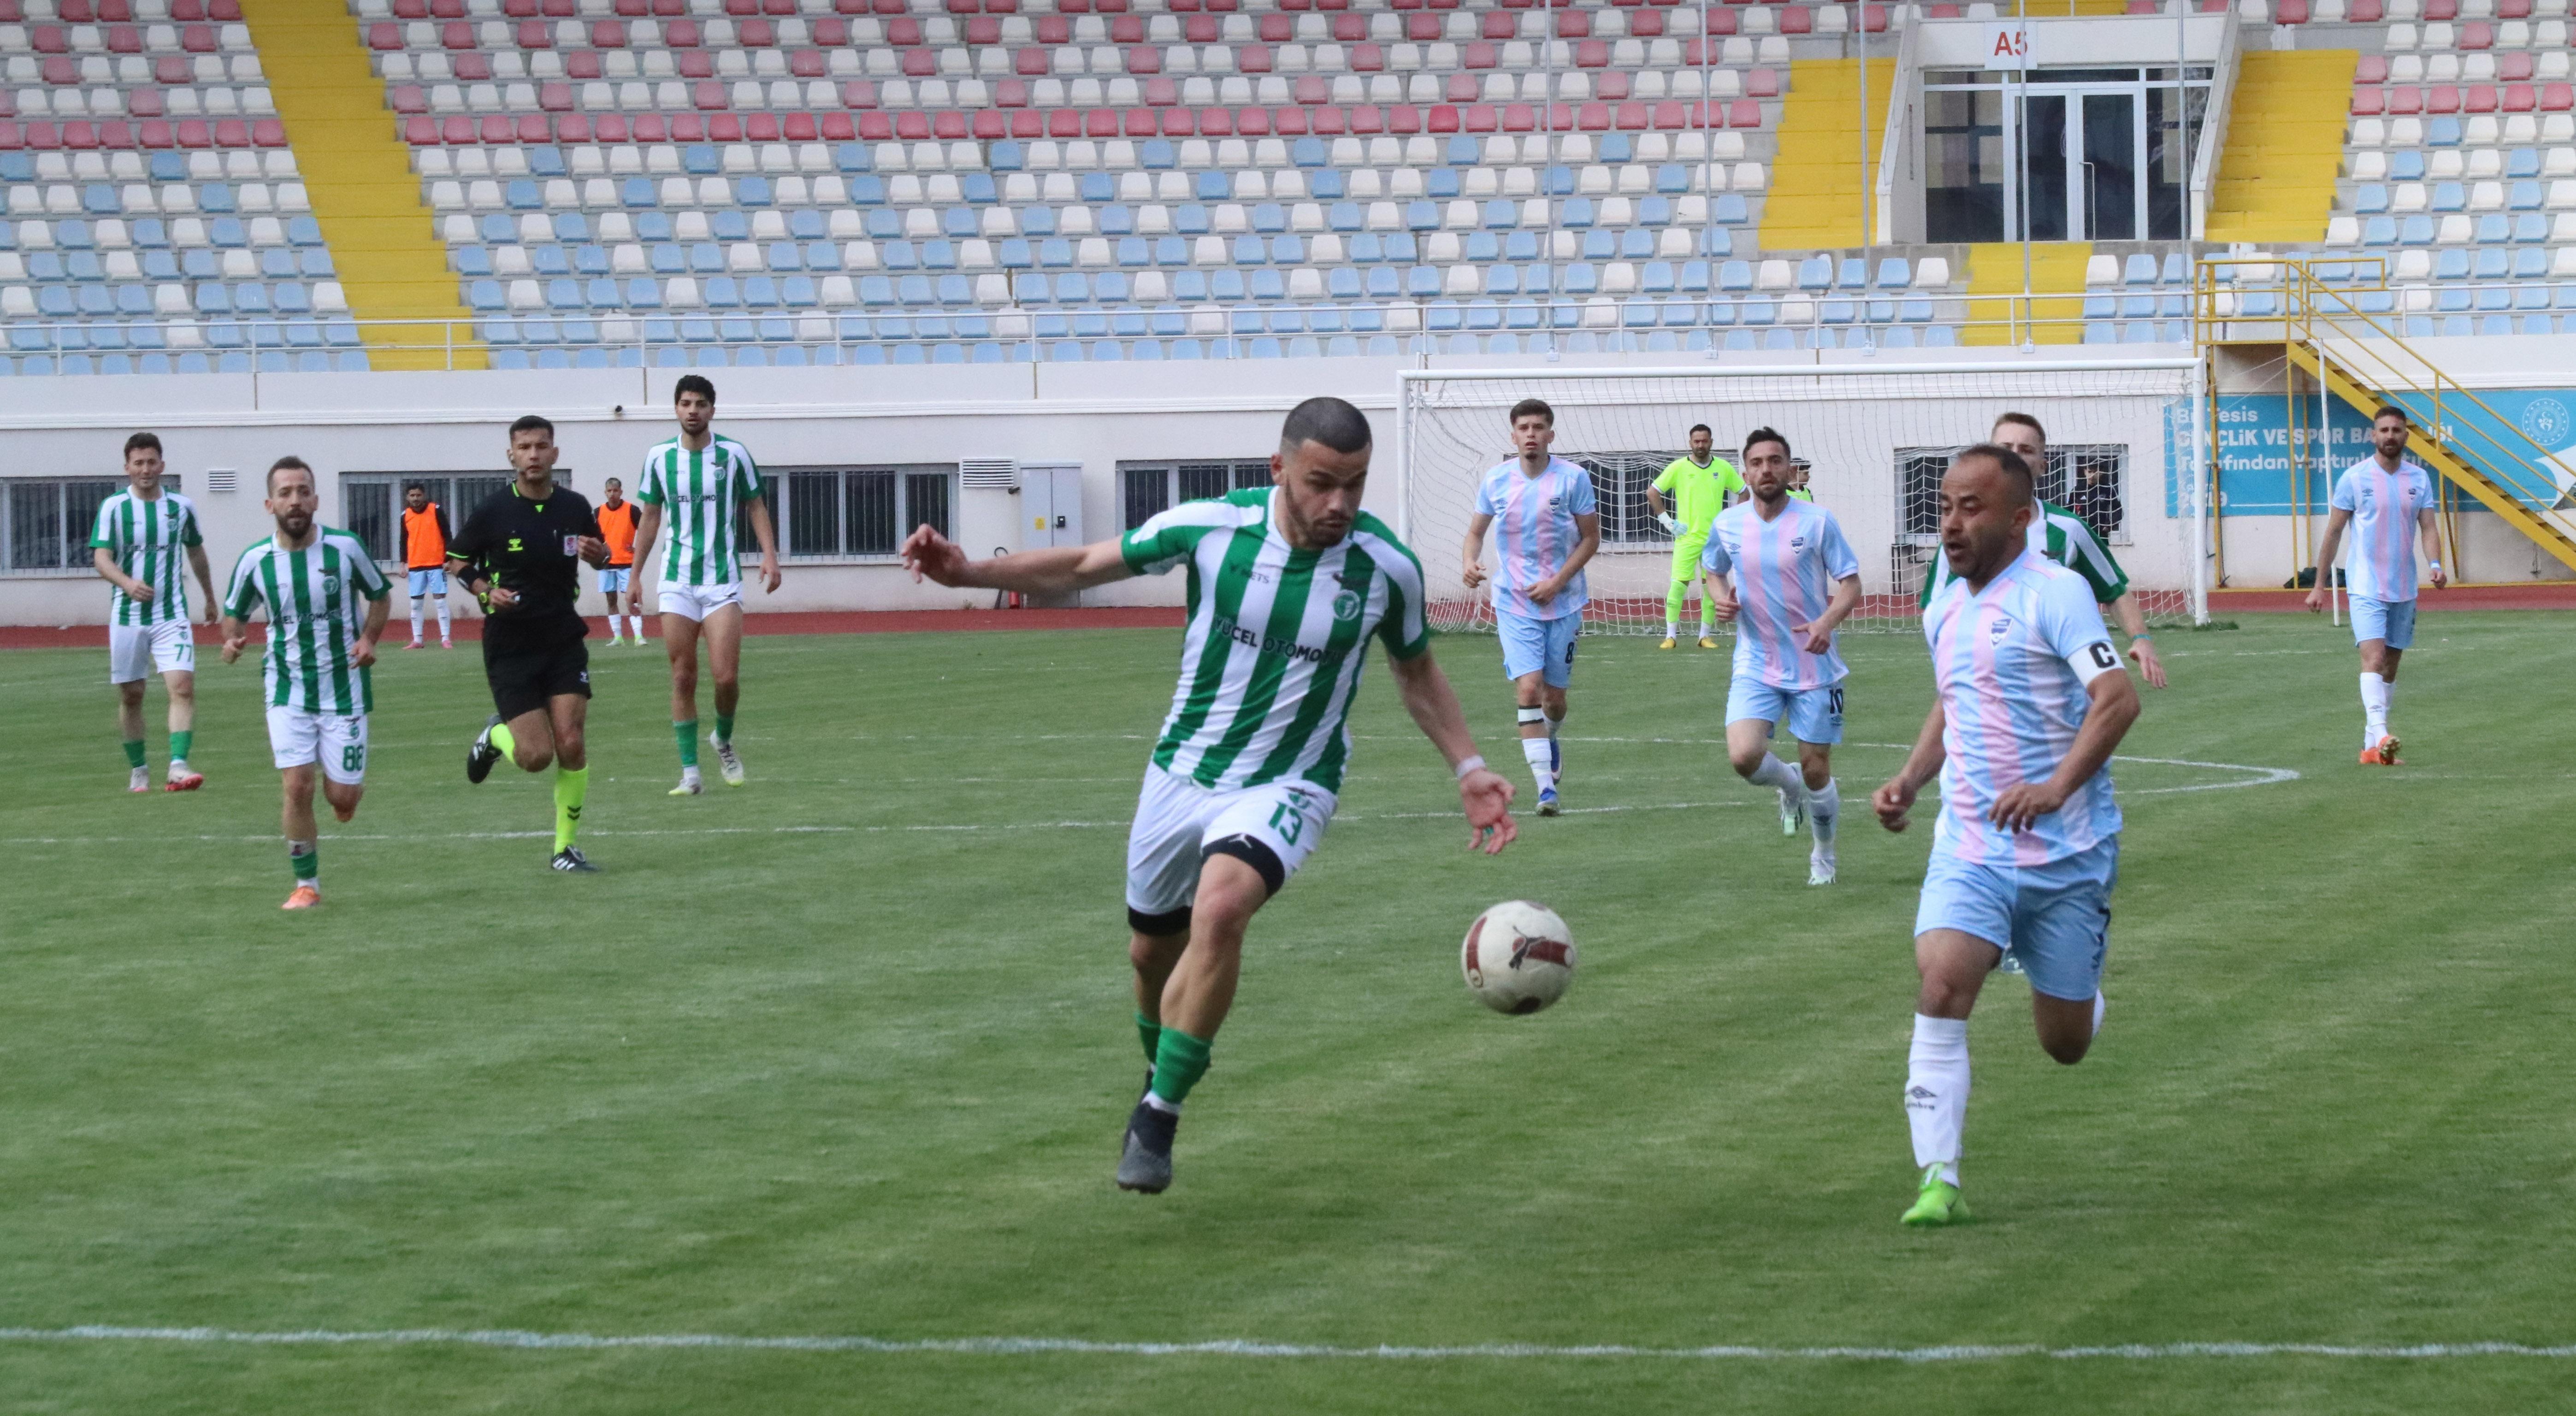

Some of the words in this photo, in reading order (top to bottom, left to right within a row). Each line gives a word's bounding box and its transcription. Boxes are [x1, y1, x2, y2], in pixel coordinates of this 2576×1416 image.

[1994, 31, 2027, 56] A5
[2263, 429, 2287, 445] VE
[2293, 427, 2345, 444] SPOR
[2179, 454, 2288, 471] Tfından
[175, 644, 192, 661] 77
[1565, 642, 1574, 664] 8
[2089, 642, 2115, 668] C
[1829, 689, 1843, 714] 10
[343, 744, 363, 772] 88
[1269, 801, 1303, 847] 13
